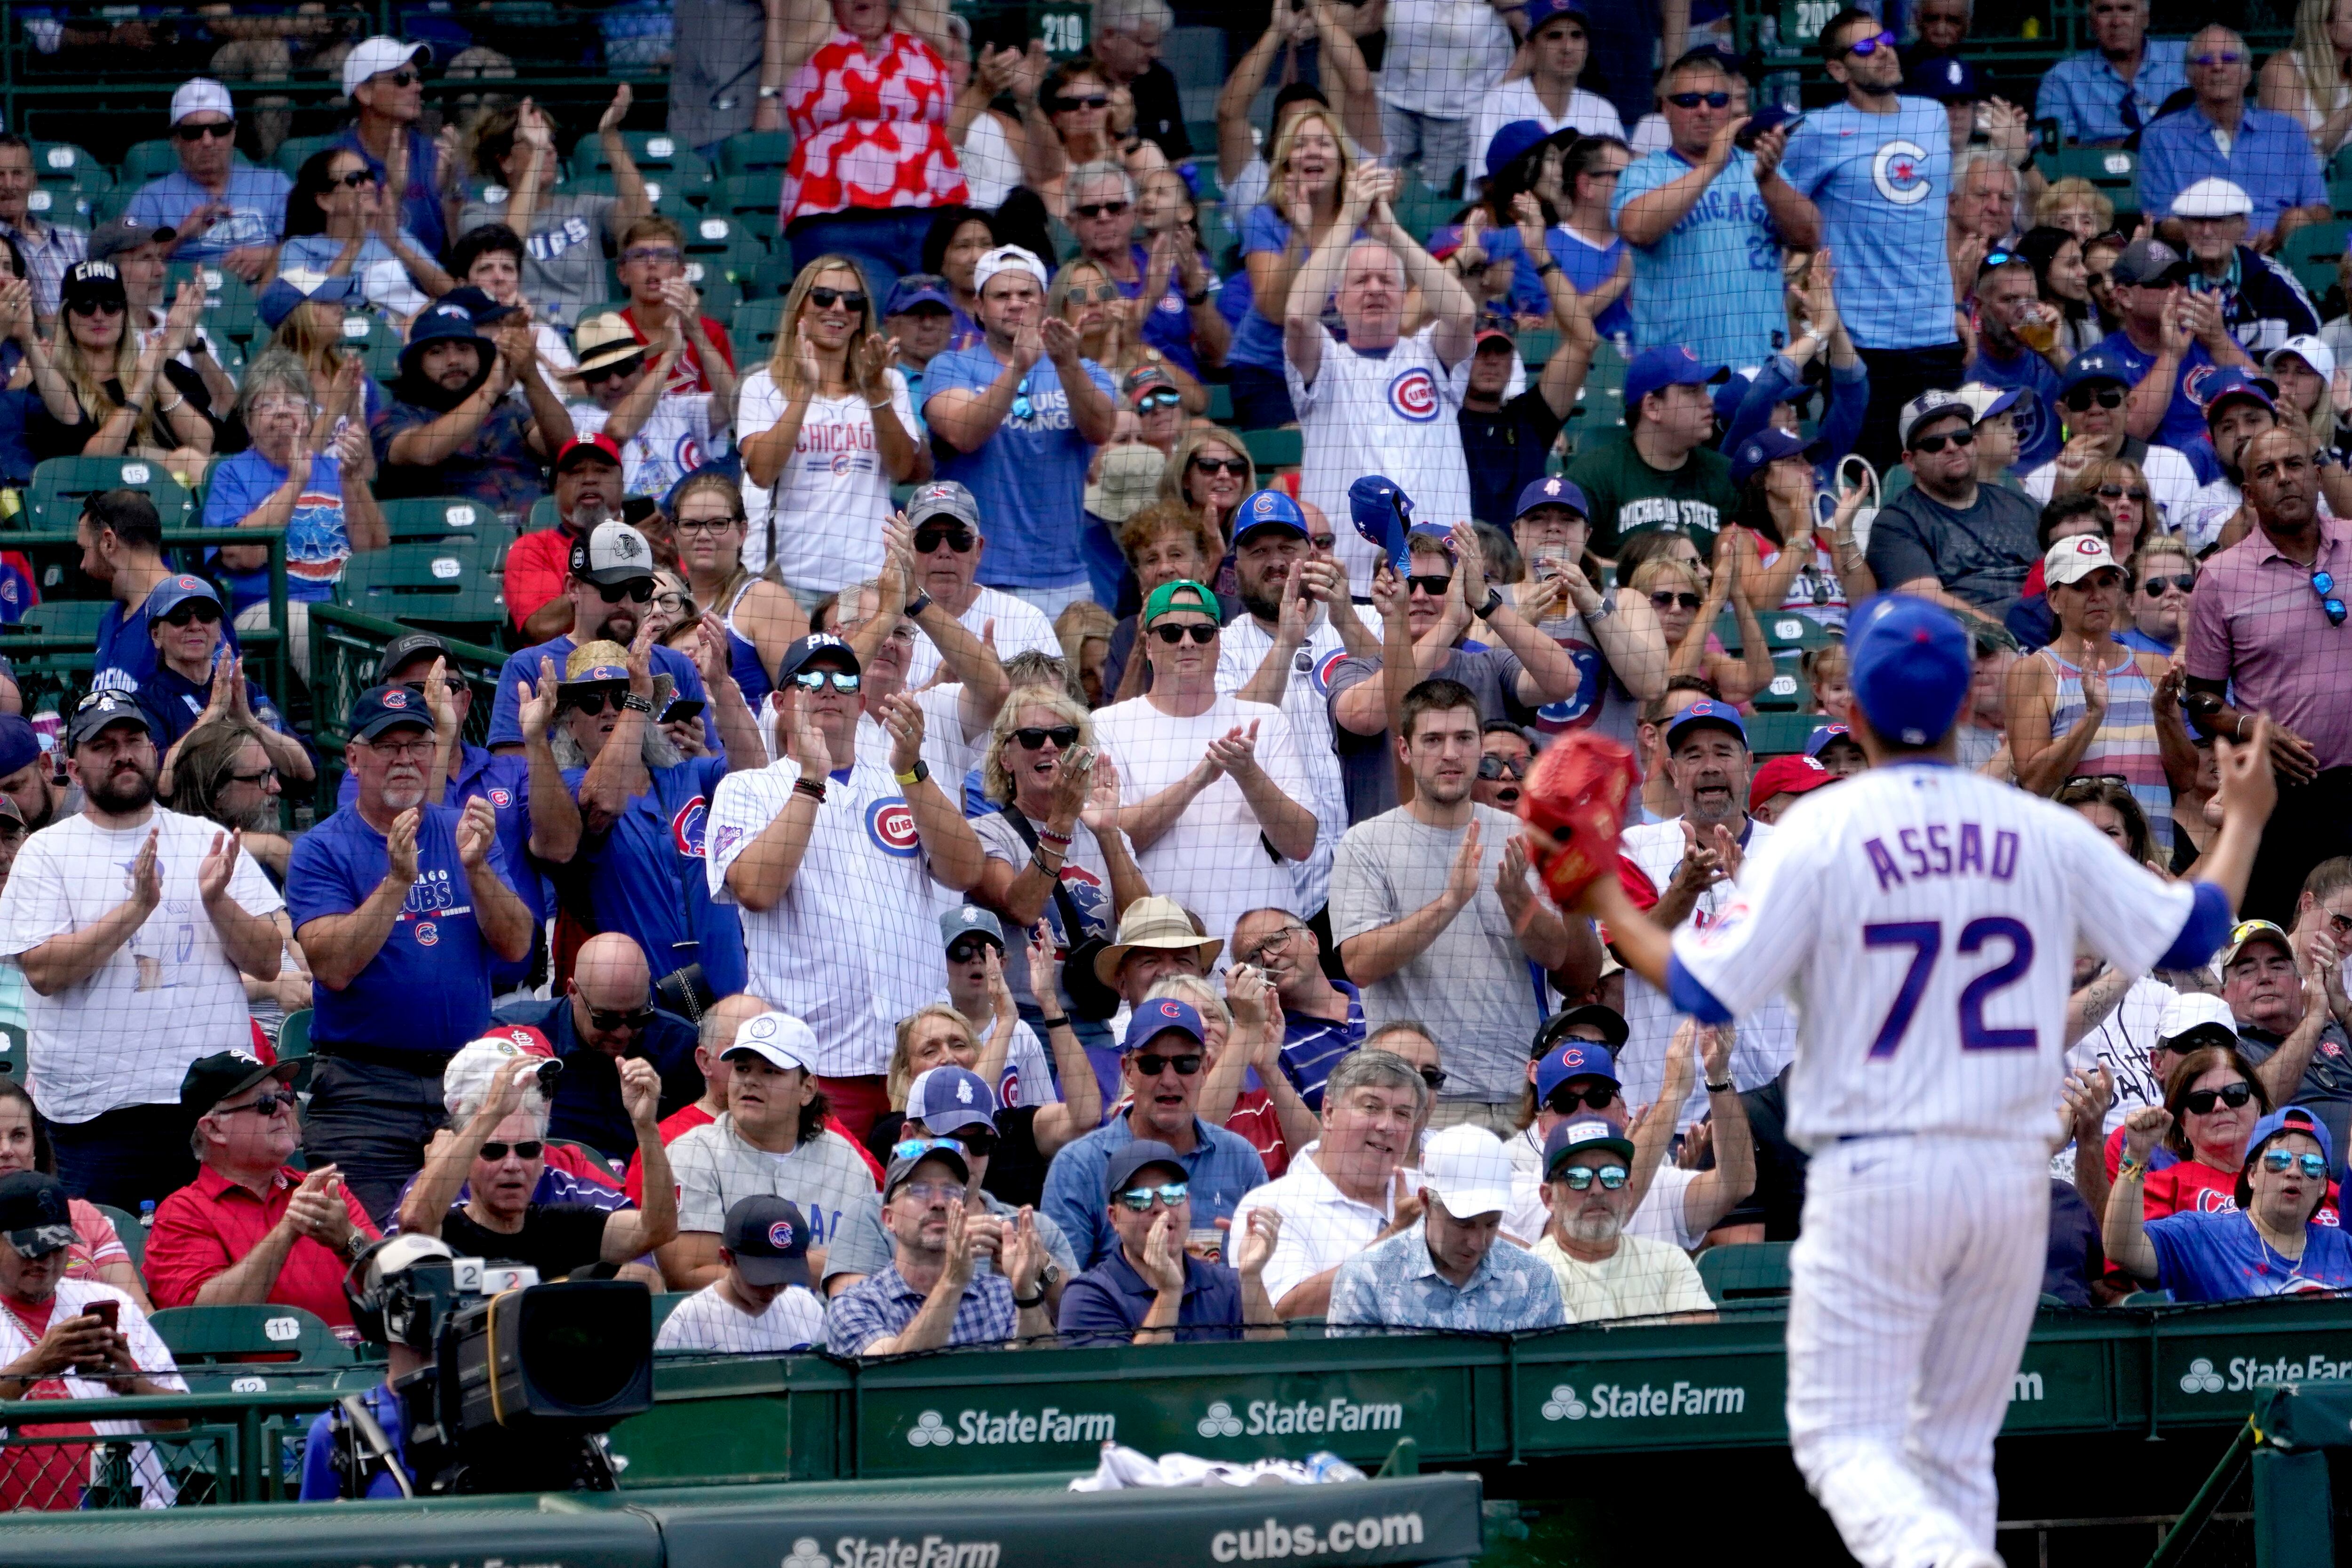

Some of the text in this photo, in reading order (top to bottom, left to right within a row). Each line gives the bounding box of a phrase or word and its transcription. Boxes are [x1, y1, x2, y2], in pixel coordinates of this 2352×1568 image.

[1041, 14, 1082, 51] 210
[1619, 500, 1720, 534] MICHIGAN STATE
[179, 577, 198, 590] C
[1691, 700, 1712, 715] C
[1864, 823, 2019, 890] ASSAD
[1863, 916, 2038, 1061] 72
[1160, 1003, 1181, 1018] C
[1563, 1050, 1584, 1067] C
[463, 1266, 477, 1285] 2
[273, 1322, 290, 1336] 11
[1211, 1511, 1423, 1563] cubs.com
